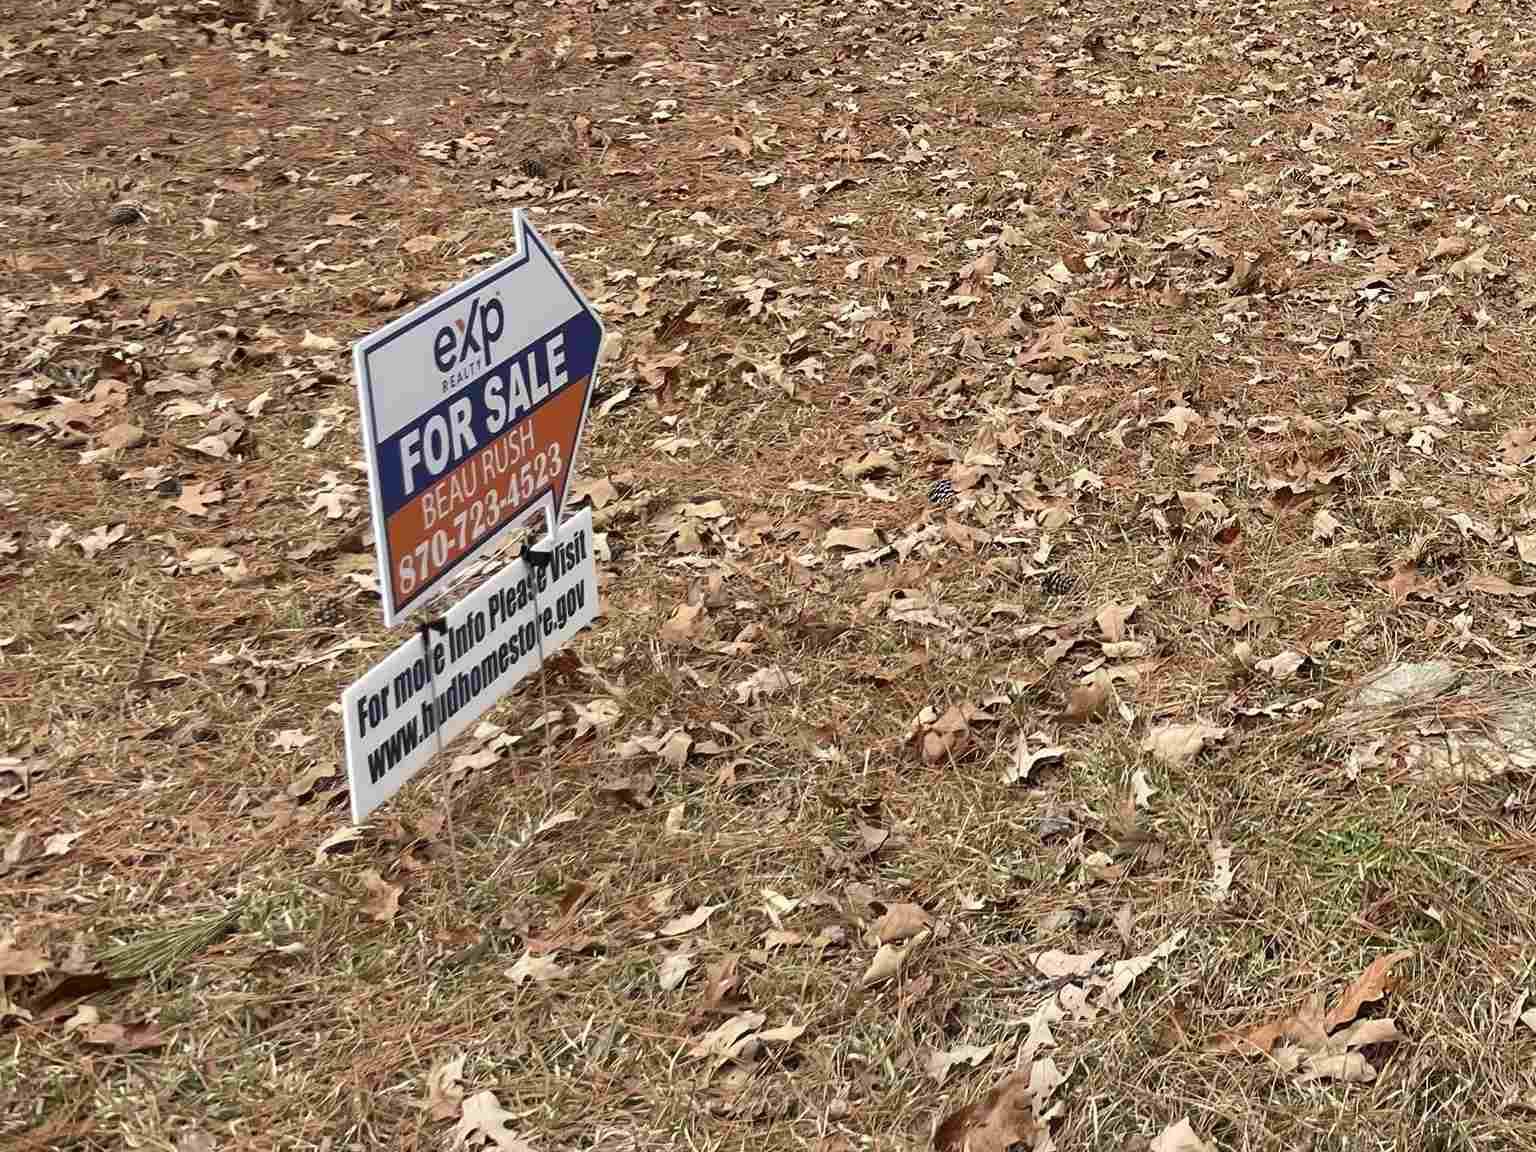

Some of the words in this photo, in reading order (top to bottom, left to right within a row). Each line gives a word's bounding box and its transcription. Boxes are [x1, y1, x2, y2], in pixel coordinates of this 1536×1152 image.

[400, 397, 478, 495] FOR
[484, 332, 569, 434] SALE
[442, 359, 481, 393] REALTY
[399, 441, 562, 595] 870-723-4523
[421, 460, 477, 530] BEAU
[481, 419, 536, 485] RUSH
[358, 685, 390, 738] For
[394, 642, 446, 710] more
[448, 611, 486, 664] Info
[488, 565, 548, 632] Please
[551, 529, 587, 583] Visit
[367, 578, 585, 785] www.hudhomestore.gov
